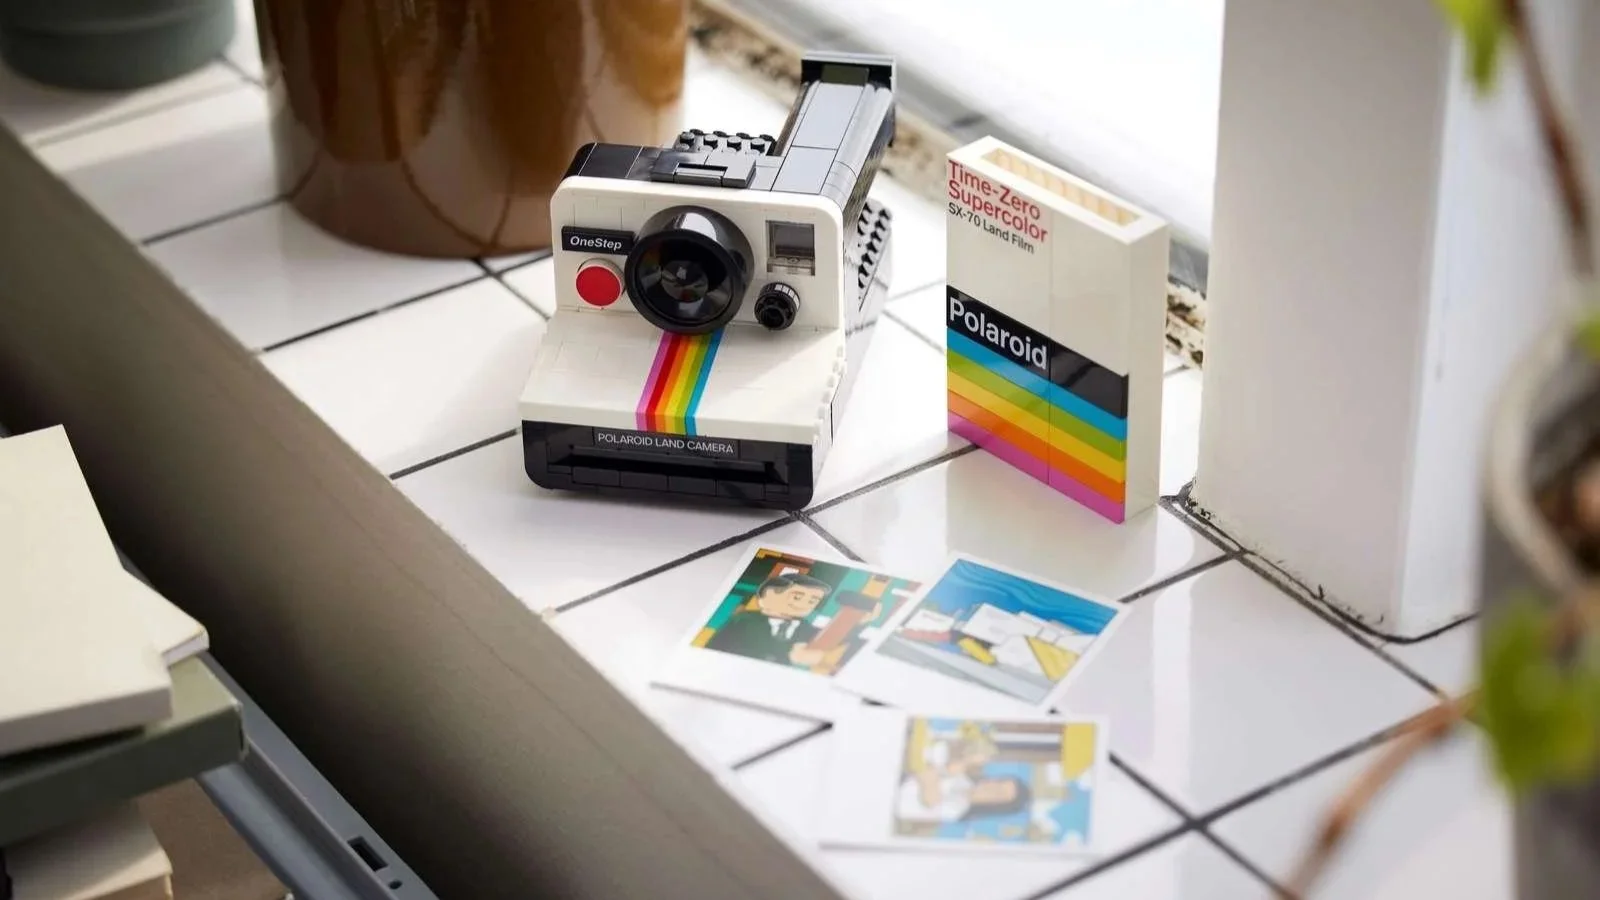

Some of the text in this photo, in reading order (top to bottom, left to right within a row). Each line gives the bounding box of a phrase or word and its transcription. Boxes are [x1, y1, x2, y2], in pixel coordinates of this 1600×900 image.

[948, 160, 1040, 221] Time-Zero
[948, 180, 1048, 243] Supercolor
[570, 235, 622, 251] OneStep
[948, 202, 1035, 254] SX-70 Land Film
[950, 296, 1047, 370] Polaroid
[598, 433, 734, 453] POLAROID LAND CAMERA
